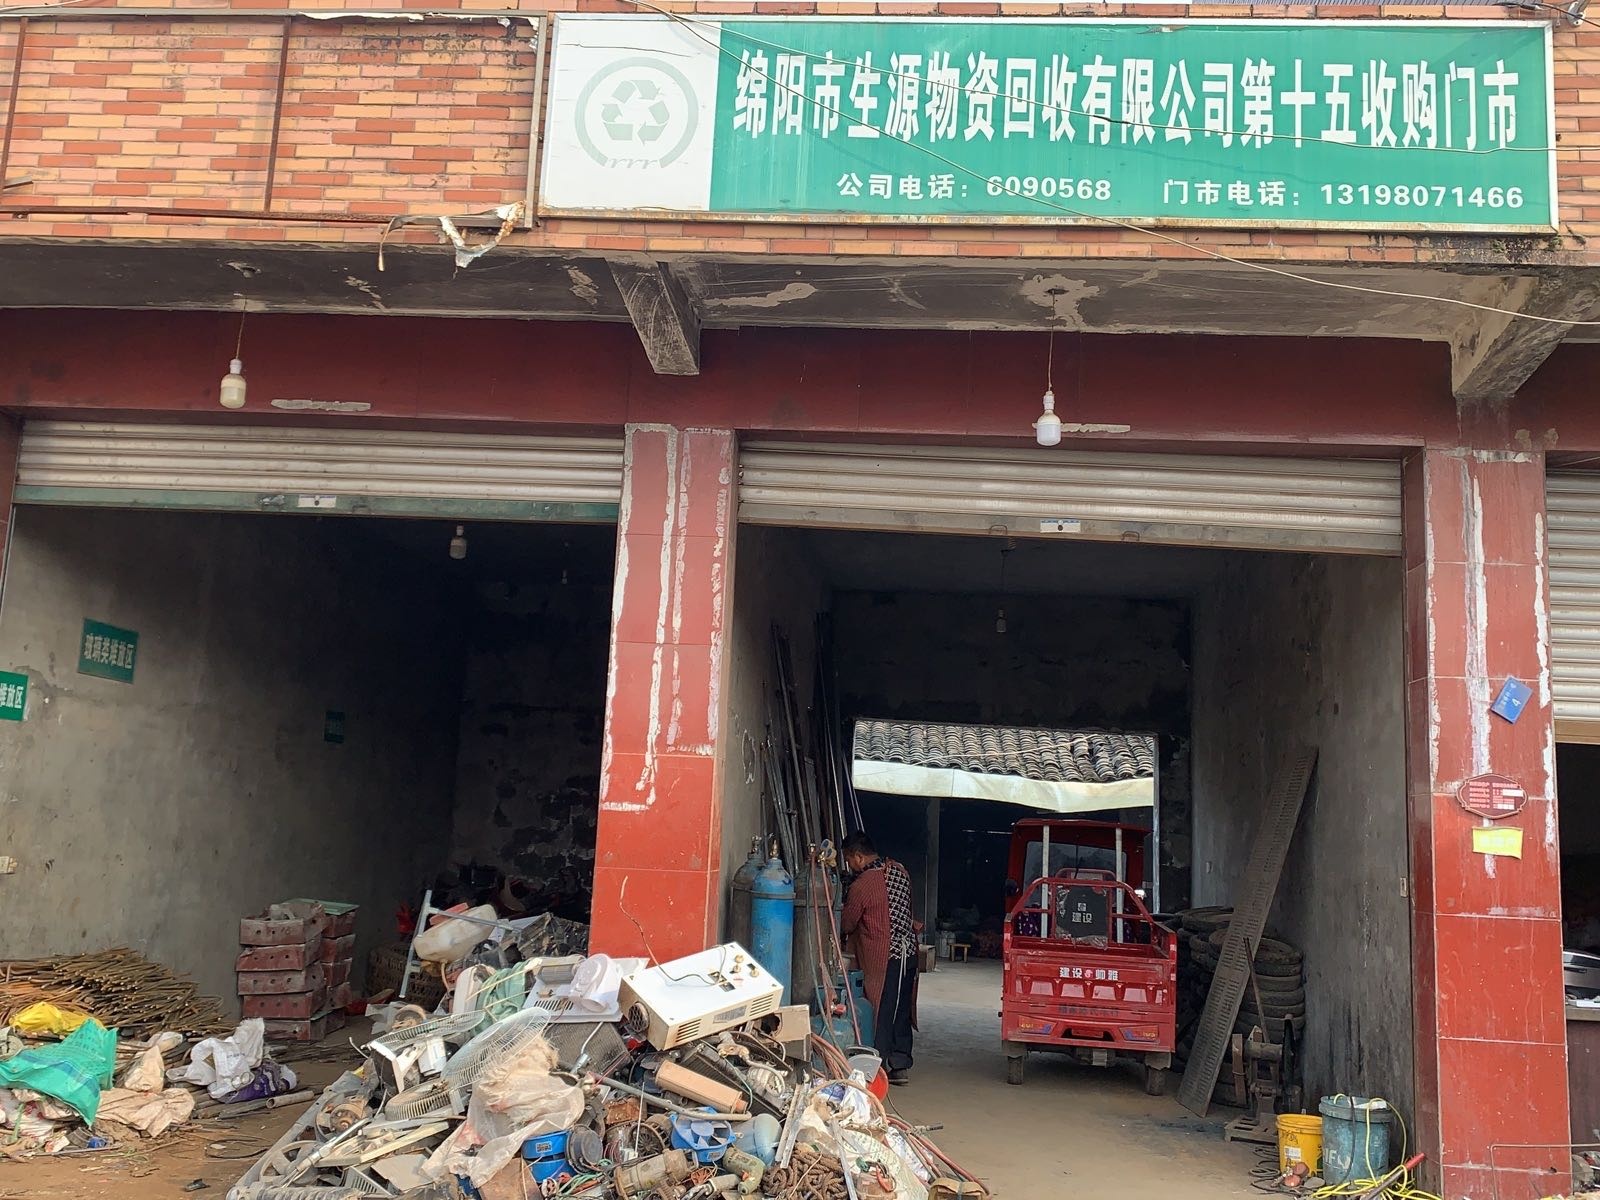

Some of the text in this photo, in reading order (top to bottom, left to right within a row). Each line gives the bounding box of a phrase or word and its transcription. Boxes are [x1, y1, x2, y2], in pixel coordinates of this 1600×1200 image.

[733, 50, 1520, 150] 绵阳市生源物资回收有限公司第十五收购门市
[985, 176, 1112, 201] 6090568
[1320, 183, 1524, 209] 13198071466
[1059, 966, 1083, 979] 建设
